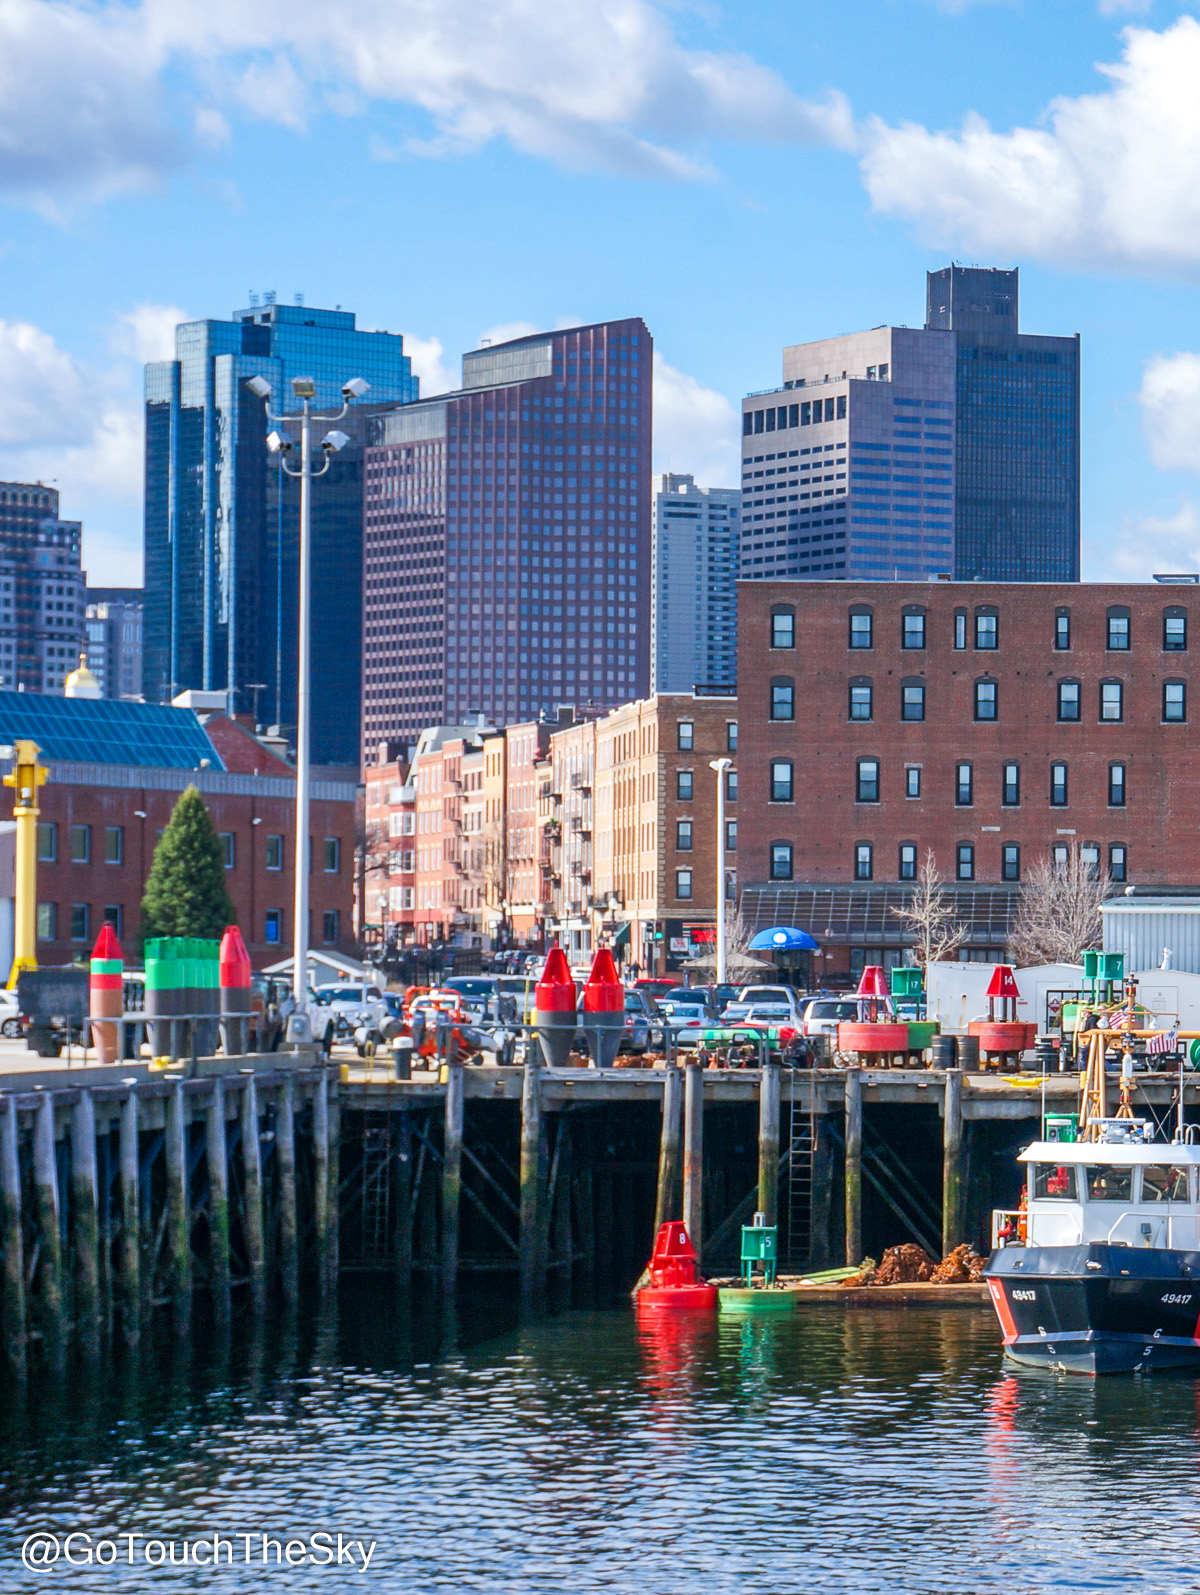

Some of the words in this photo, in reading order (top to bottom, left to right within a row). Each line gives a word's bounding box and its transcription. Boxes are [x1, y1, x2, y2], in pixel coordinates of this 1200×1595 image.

[1116, 961, 1121, 971] 7
[910, 981, 919, 989] 17
[1004, 975, 1013, 986] 14
[679, 1233, 686, 1244] 8
[766, 1237, 772, 1247] 5
[1011, 1290, 1036, 1301] 49417
[1160, 1293, 1192, 1304] 49417
[1038, 1326, 1047, 1337] 6
[1153, 1328, 1163, 1339] 6
[1047, 1344, 1056, 1355] 5
[1143, 1345, 1153, 1356] 5
